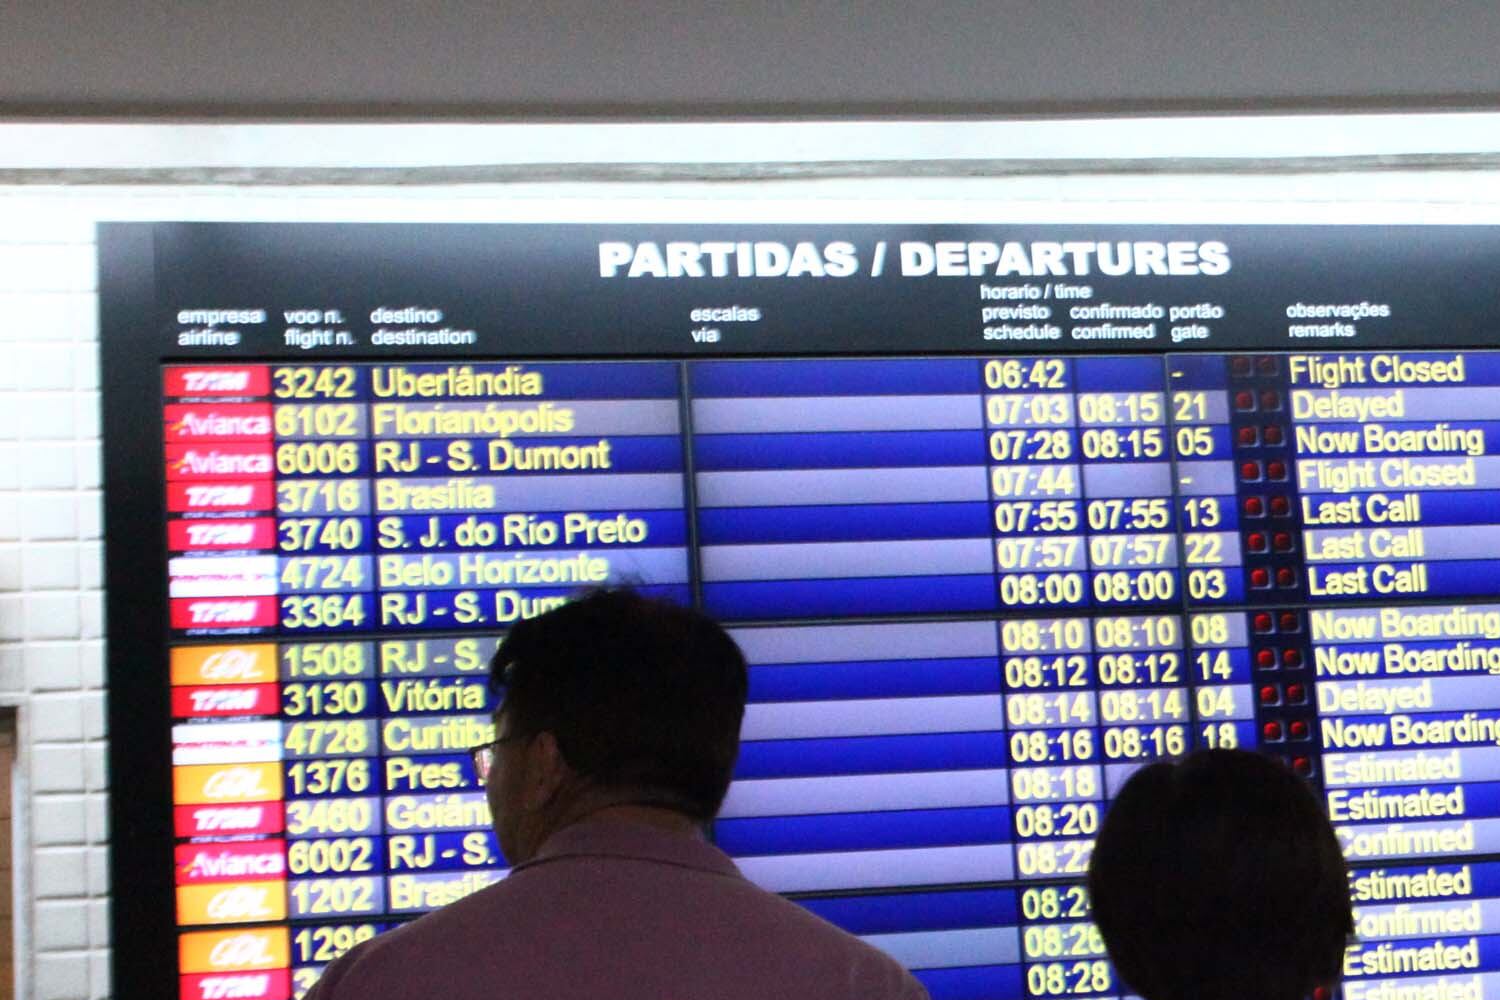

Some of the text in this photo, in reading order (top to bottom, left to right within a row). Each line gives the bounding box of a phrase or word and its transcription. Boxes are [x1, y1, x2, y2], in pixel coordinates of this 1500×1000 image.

[598, 239, 1231, 277] PARTIDAS / DEPARTURES
[1054, 284, 1092, 298] time
[177, 310, 265, 327] empresa
[284, 310, 322, 324] voo
[370, 307, 442, 323] destino
[690, 306, 761, 321] escalas
[982, 304, 1051, 323] previsto
[1070, 303, 1164, 319] confirmado
[1170, 303, 1224, 322] portão
[1286, 302, 1390, 320] observações
[178, 329, 240, 345] airline
[284, 328, 333, 349] flight
[371, 328, 476, 345] destination
[691, 327, 720, 342] via
[984, 324, 1061, 340] schedule
[1072, 323, 1156, 339] confirmed
[1171, 324, 1209, 342] gate
[1289, 322, 1356, 337] remarks
[274, 367, 355, 398] 3242
[372, 366, 541, 397] Uberlândia
[985, 360, 1064, 387] 06:42
[1289, 355, 1464, 388] Flight Closed
[273, 404, 357, 436] 6102
[988, 395, 1069, 423] 07:03
[1080, 393, 1160, 422] 08:15
[1174, 392, 1206, 421] 21
[1293, 390, 1404, 421] Delayed
[373, 403, 574, 439] Florianópolis
[990, 432, 1069, 459] 07:28
[1082, 429, 1162, 457] 08:15
[1177, 427, 1212, 455] 05
[1297, 425, 1484, 455] Now Boarding
[276, 443, 357, 473] 6006
[375, 441, 418, 471] RJ
[489, 440, 609, 470] Dumont
[277, 480, 359, 512] 3716
[376, 478, 494, 510] Brasília
[996, 502, 1076, 531] 07:55
[1088, 500, 1168, 529] 07:55
[1186, 499, 1219, 525] 13
[1303, 495, 1419, 524] Last Call
[279, 519, 360, 550] 3740
[456, 519, 495, 545] do
[504, 516, 556, 544] Rio
[566, 514, 645, 542] Preto
[381, 556, 608, 586] Belo Horizonte
[1189, 570, 1226, 598] 03
[1309, 565, 1426, 594] Last Call
[1001, 574, 1081, 604] 08:00
[1094, 572, 1173, 601] 08:00
[284, 597, 362, 627] 3364
[283, 642, 364, 677] 1508
[1005, 656, 1085, 687] 08:12
[1099, 653, 1178, 684] 08:12
[1199, 653, 1230, 679] 14
[1315, 649, 1378, 674] Now
[284, 682, 365, 715] 3130
[381, 681, 484, 712] Vitória
[285, 720, 368, 754] 4728
[1011, 730, 1091, 761] 08:16
[1104, 726, 1184, 757] 08:16
[1322, 721, 1385, 746] Now
[289, 759, 367, 793] 1376
[1328, 789, 1463, 821] Estimated
[1016, 805, 1097, 836] 08:20
[288, 839, 370, 873] 6002
[1343, 941, 1478, 975] Estimated
[1028, 962, 1110, 995] 08:28
